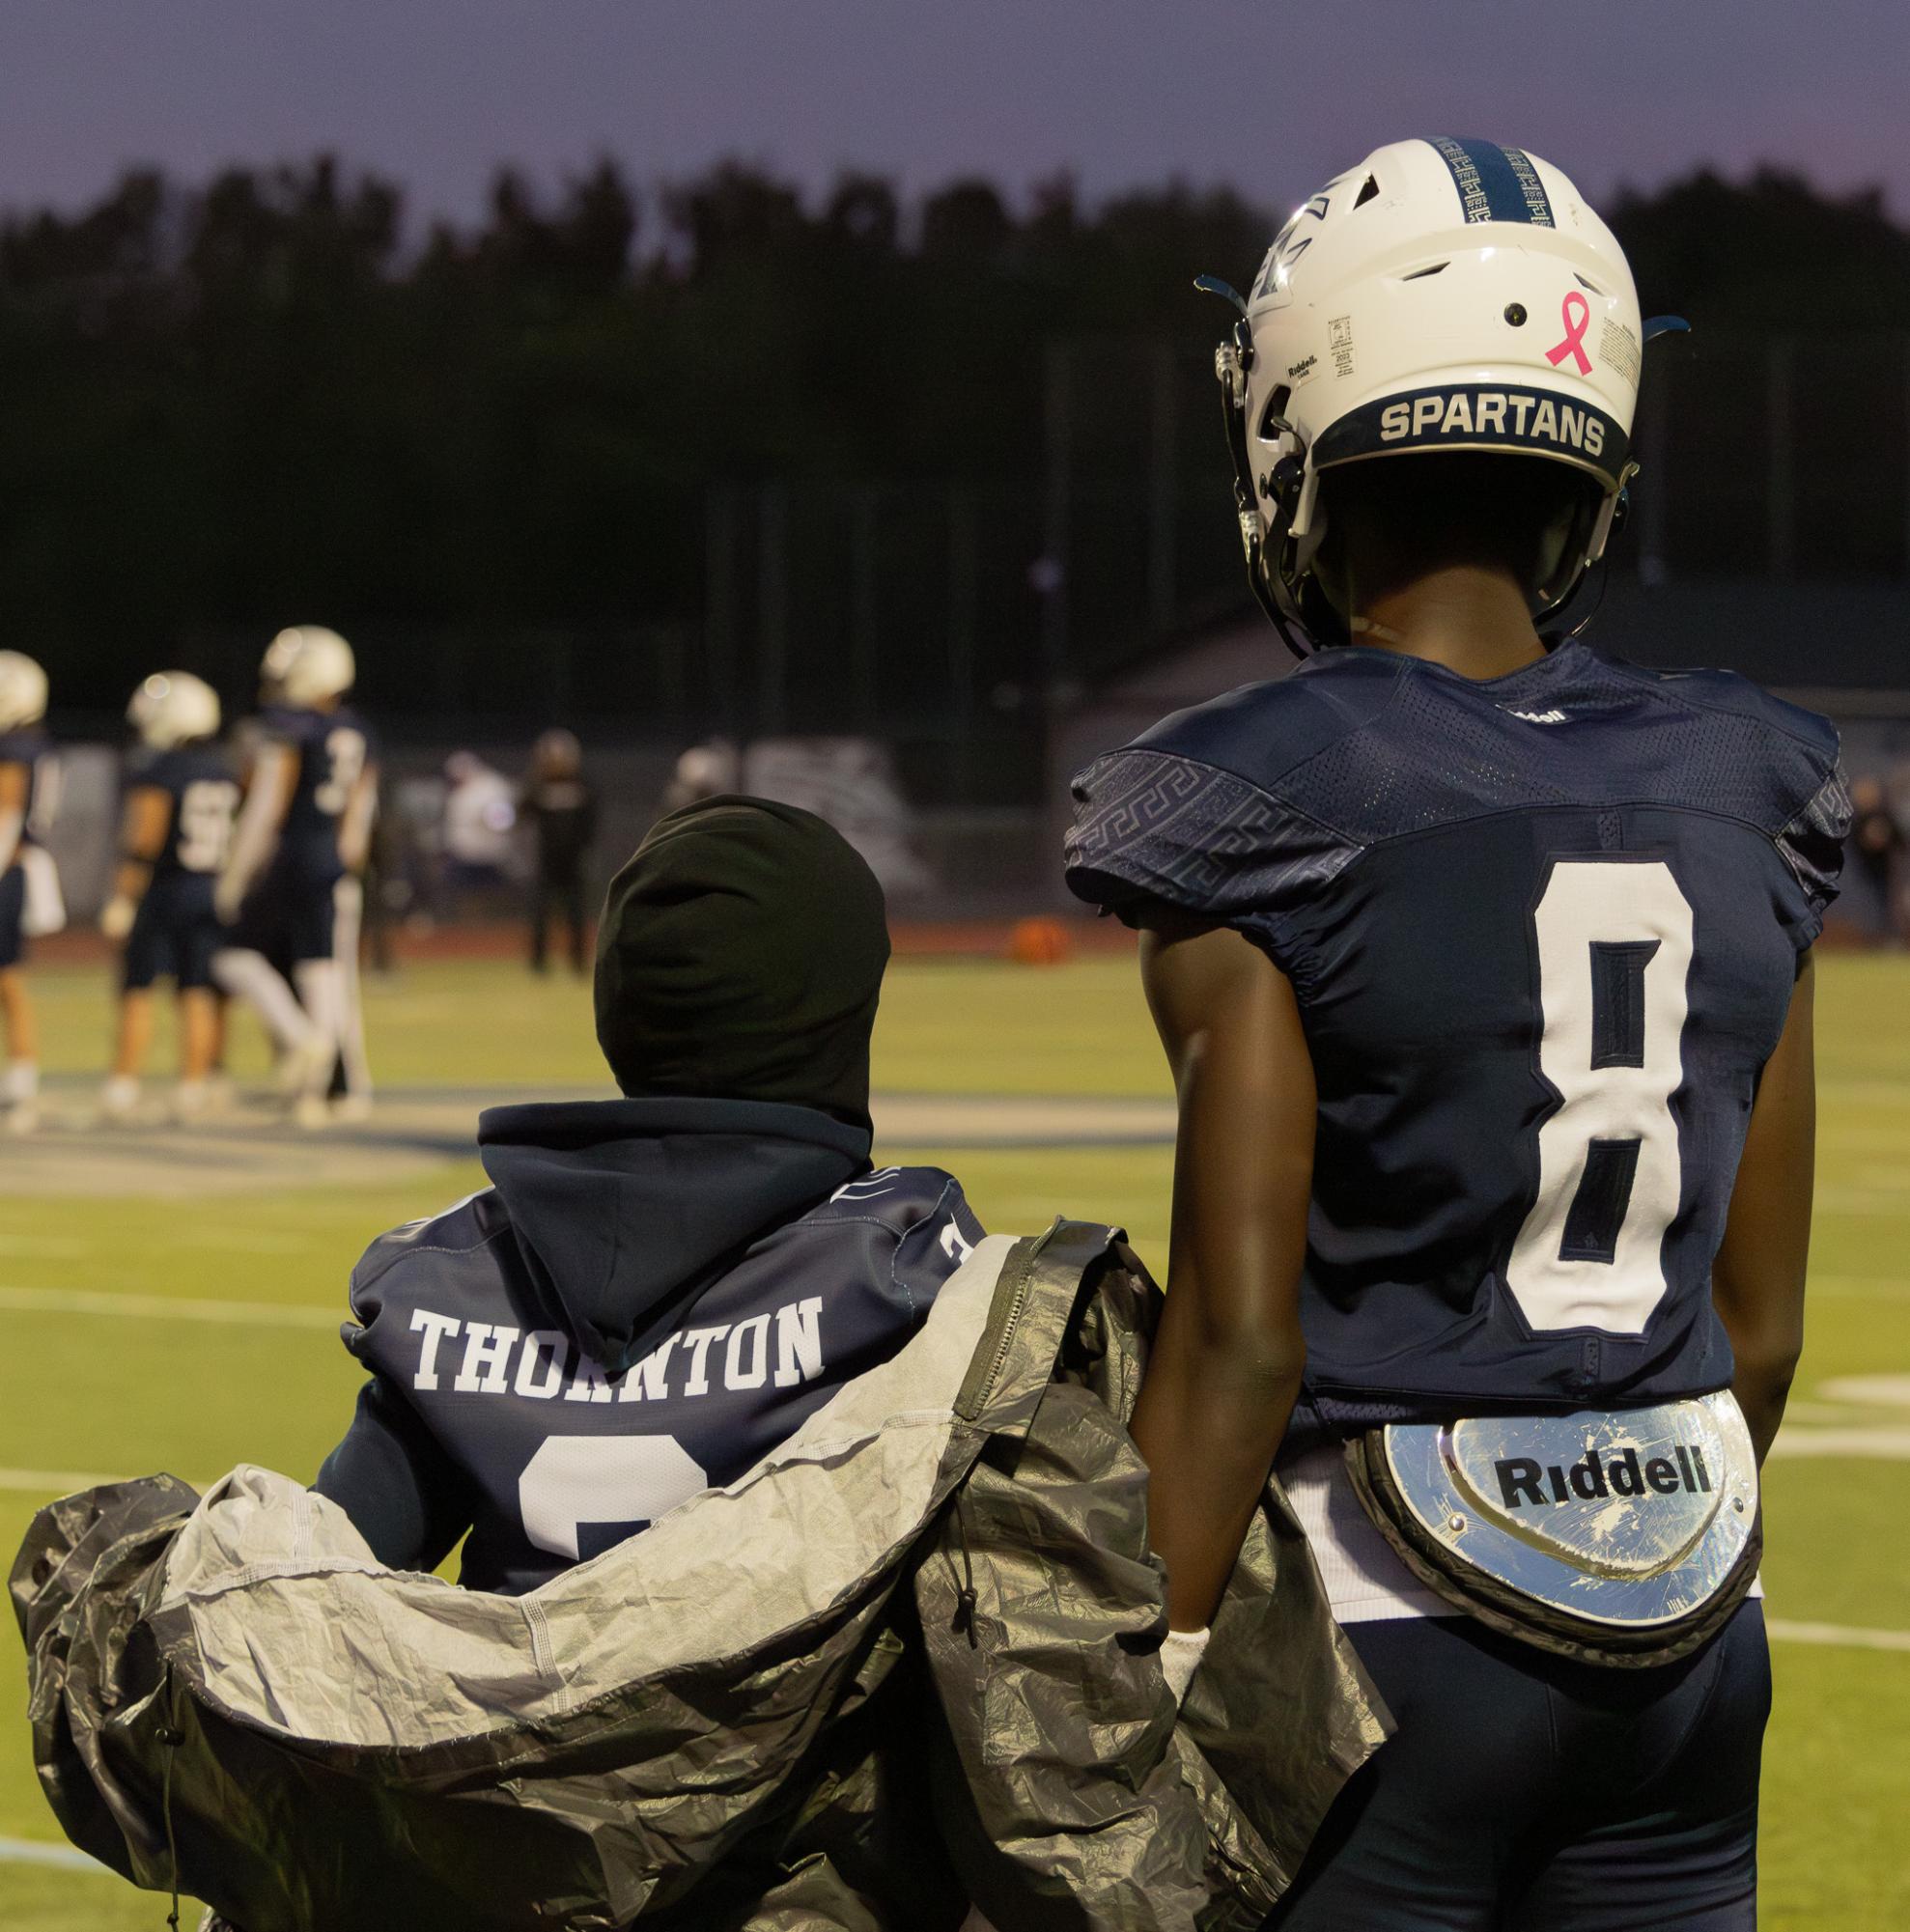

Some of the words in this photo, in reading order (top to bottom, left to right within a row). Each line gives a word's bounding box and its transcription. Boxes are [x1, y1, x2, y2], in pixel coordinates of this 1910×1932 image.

[1288, 355, 1315, 378] Riddell
[1380, 392, 1606, 458] SPARTANS
[1505, 860, 1694, 1332] 8
[1493, 1444, 1713, 1510] Riddell
